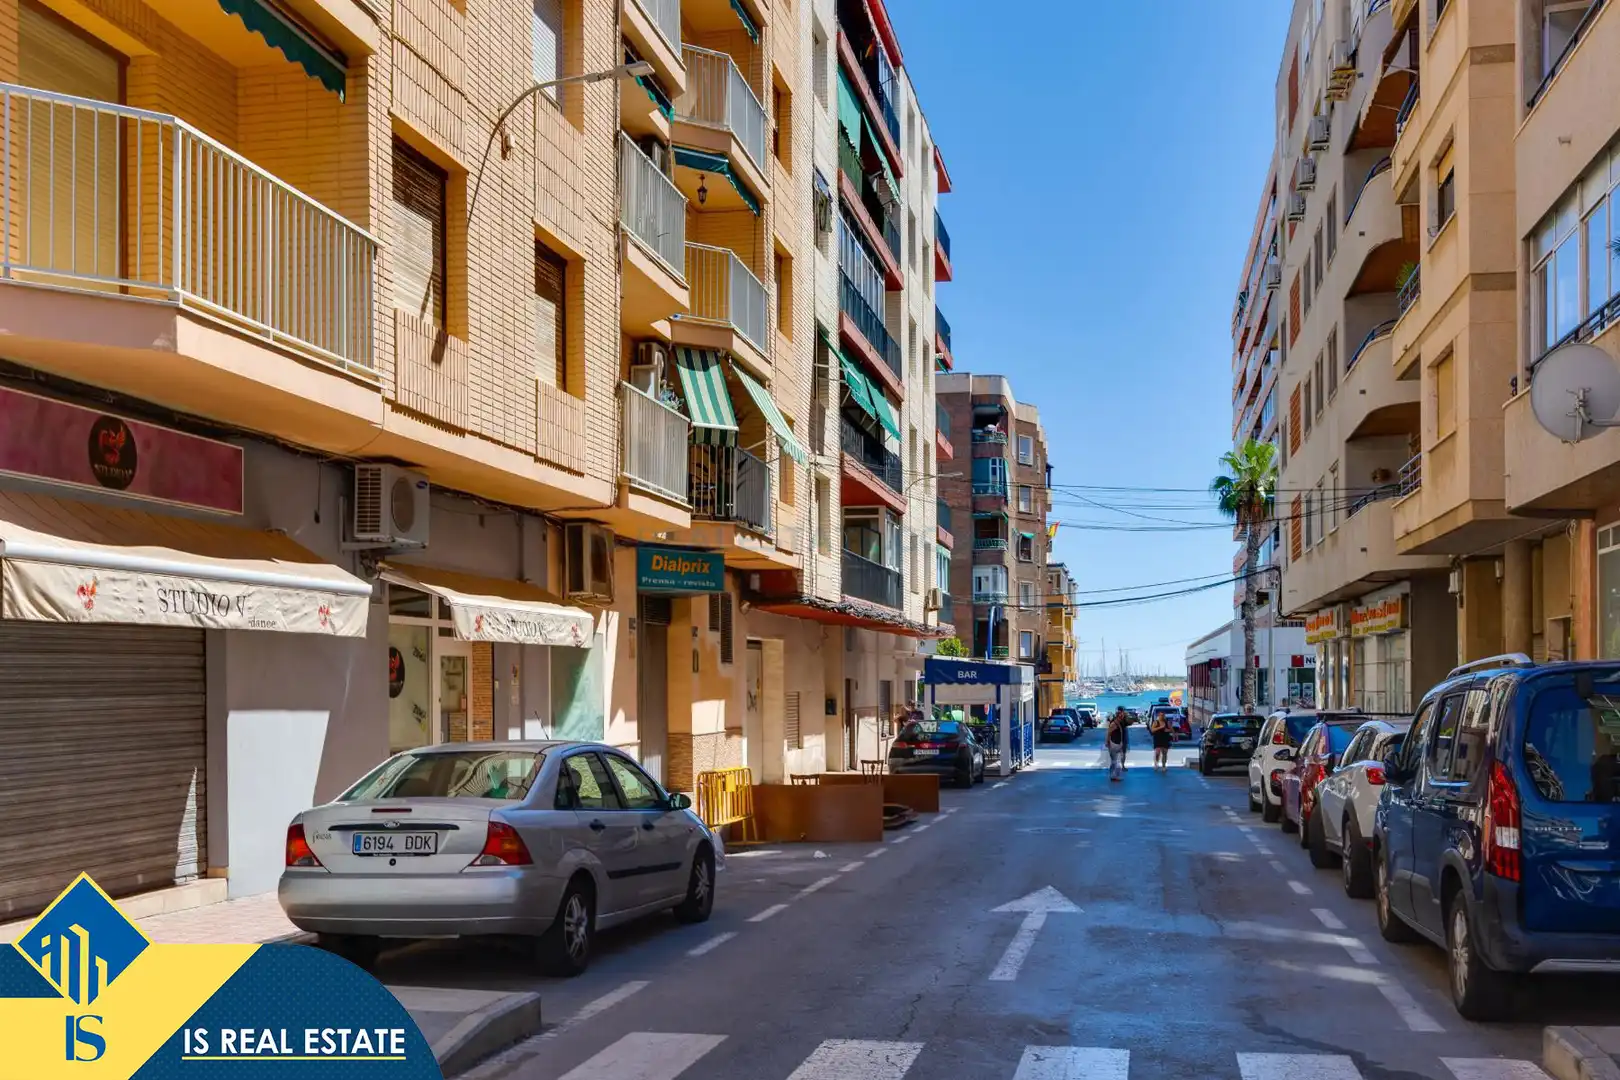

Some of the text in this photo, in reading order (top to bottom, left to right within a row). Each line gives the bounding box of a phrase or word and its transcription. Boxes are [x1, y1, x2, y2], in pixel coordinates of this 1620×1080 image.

[651, 554, 711, 575] Dialprix
[641, 576, 676, 585] Prensa
[156, 588, 247, 618] STUDIO V
[957, 670, 978, 679] BAR
[363, 835, 394, 850] 6194
